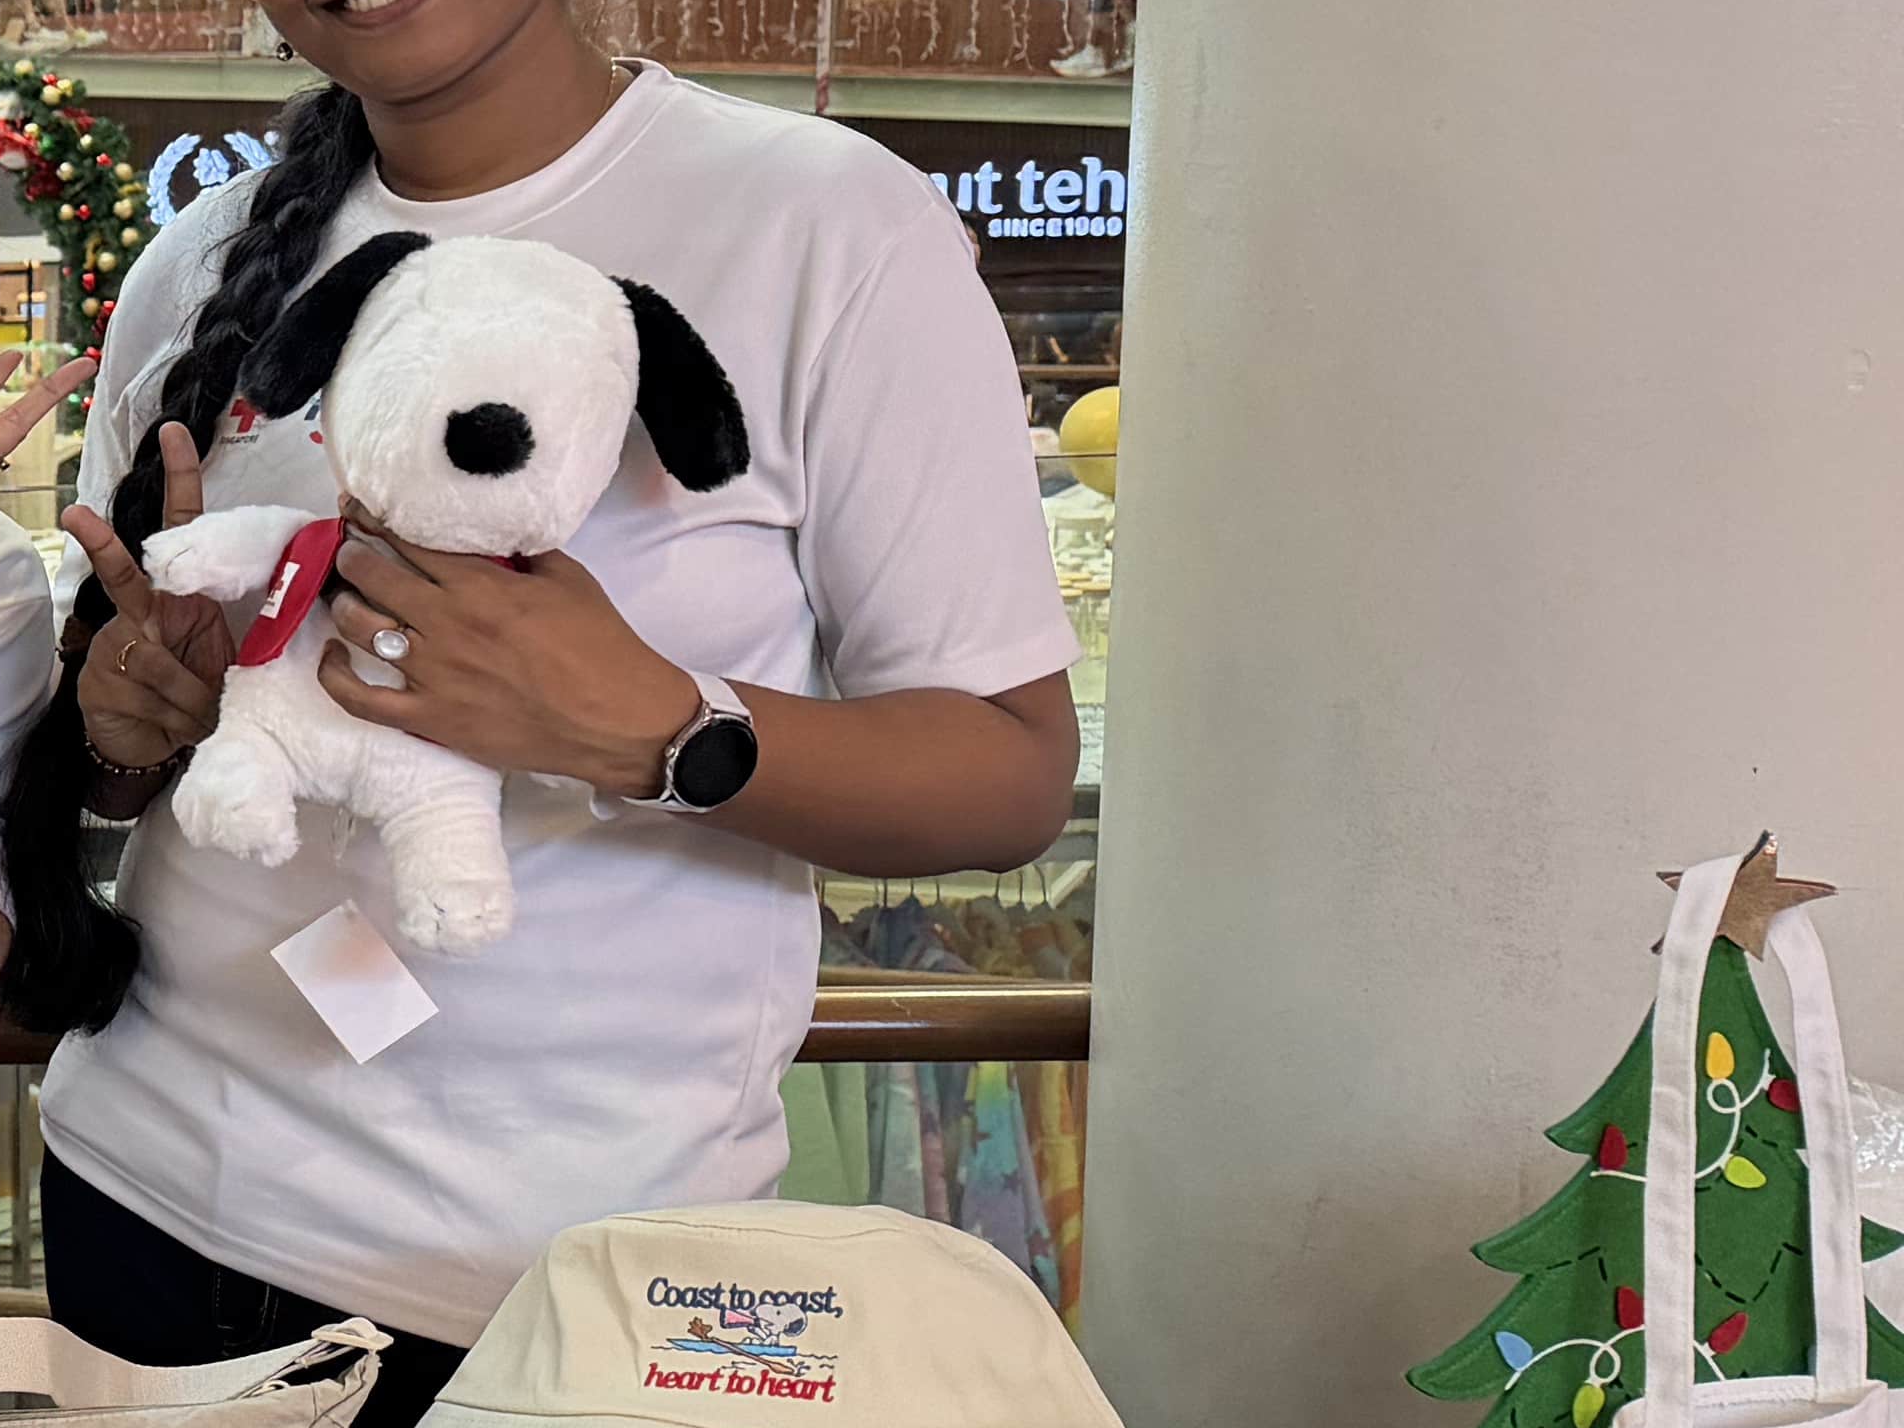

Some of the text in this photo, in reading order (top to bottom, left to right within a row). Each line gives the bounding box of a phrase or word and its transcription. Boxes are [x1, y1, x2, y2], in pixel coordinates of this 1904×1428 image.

[1016, 155, 1125, 215] teh
[647, 1276, 724, 1309] Coast
[729, 1281, 756, 1310] to
[643, 1362, 837, 1402] heart to heart
